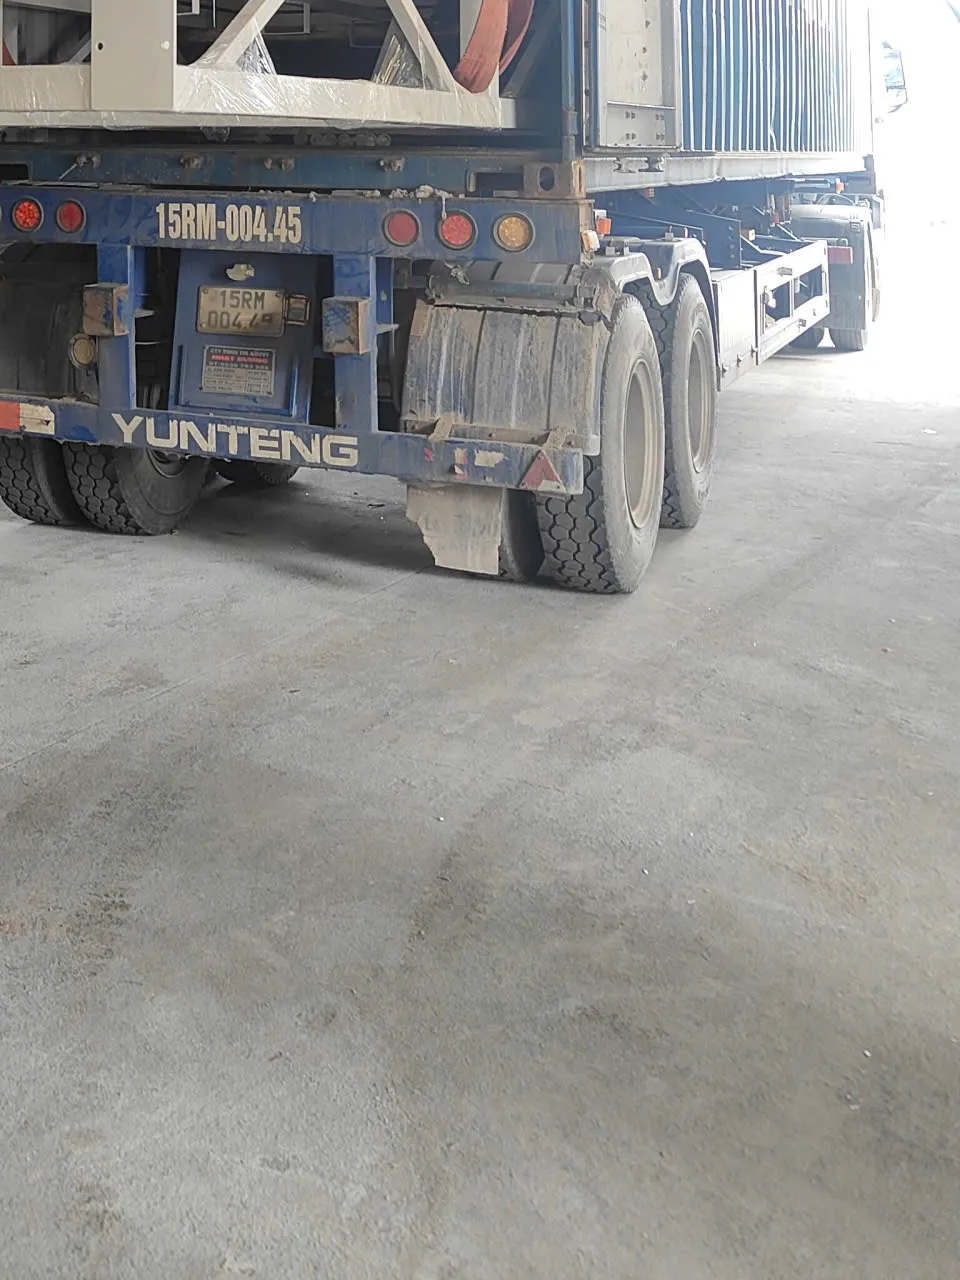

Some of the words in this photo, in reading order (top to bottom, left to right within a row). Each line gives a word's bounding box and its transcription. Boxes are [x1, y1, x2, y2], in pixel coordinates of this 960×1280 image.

[156, 203, 302, 244] 15RM-004.45
[220, 290, 265, 311] 15RM
[111, 413, 359, 467] YUNTENG
